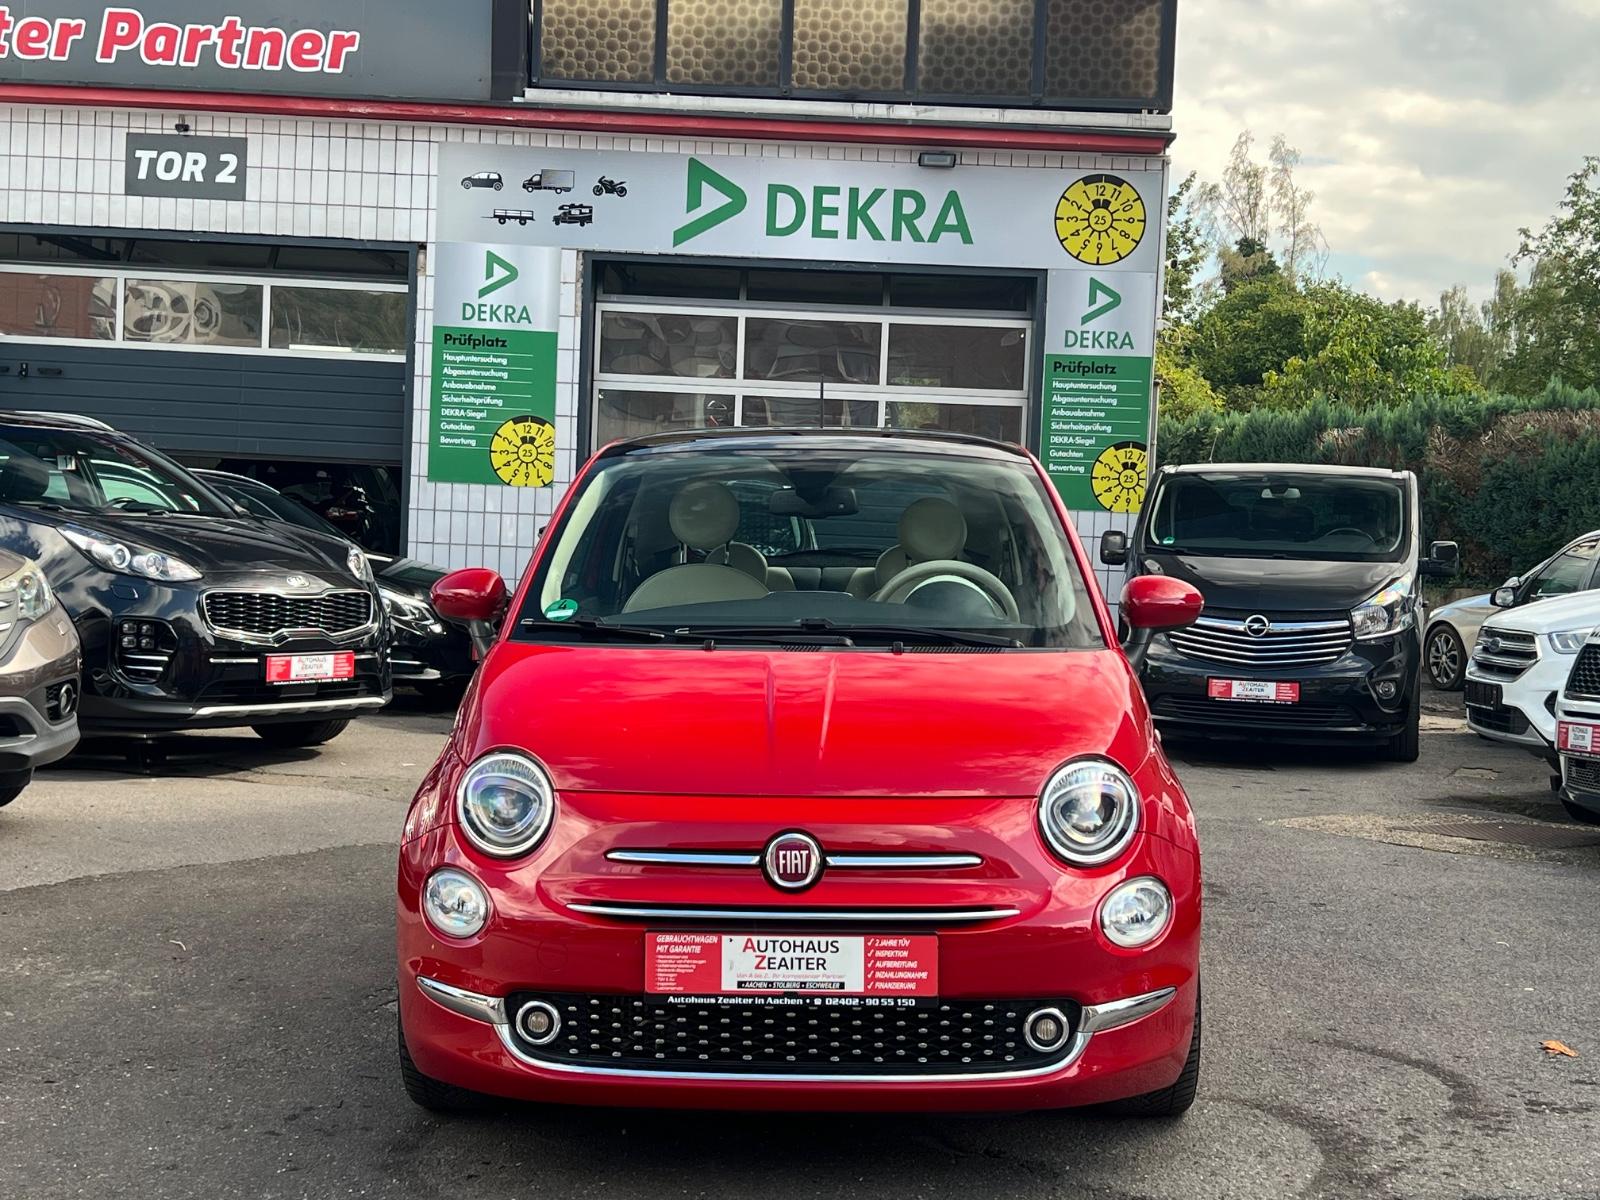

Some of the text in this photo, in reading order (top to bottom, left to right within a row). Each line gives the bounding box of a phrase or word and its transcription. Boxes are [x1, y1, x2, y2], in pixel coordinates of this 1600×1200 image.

[97, 8, 359, 73] Partner
[134, 150, 238, 184] TOR 2
[1095, 184, 1106, 197] 12
[1110, 187, 1122, 202] 11
[1070, 200, 1082, 211] 2
[1119, 198, 1134, 213] 10
[765, 183, 974, 246] DEKRA
[1066, 215, 1079, 223] 3
[1094, 215, 1106, 225] 25
[1119, 229, 1131, 240] 8
[1080, 238, 1091, 251] 5
[462, 302, 533, 325] DEKRA
[443, 333, 508, 350] Prüfplatz
[1064, 329, 1135, 350] DEKRA
[442, 352, 508, 366] Hauptuntersuchung
[442, 366, 509, 380] Abgasuntersuchung
[1053, 361, 1117, 377] Prüfplatz
[441, 380, 497, 391] Anbauabnahme
[1052, 380, 1117, 392] Hauptuntersuchung
[441, 394, 503, 407] Sicherheitsprüfung
[1052, 394, 1118, 406] Abgasuntersuchung
[441, 408, 487, 419] DEKRA-Siegel
[1051, 408, 1106, 418] Anbauabnahme
[440, 422, 475, 431] Gutachten
[523, 424, 532, 434] 12
[1050, 421, 1112, 434] Sicherheitsprüfung
[440, 435, 476, 447] Bewertung
[1050, 436, 1096, 447] DEKRA-Siegel
[522, 449, 533, 458] 25
[1049, 449, 1084, 459] Gutachten
[1124, 450, 1134, 460] 12
[1048, 463, 1085, 475] Bewertung
[1123, 474, 1134, 484] 25
[779, 850, 809, 874] FIAT
[656, 934, 718, 944] GEBRAUCHTWAGEN
[898, 937, 911, 947] TÜV
[656, 944, 701, 954] MIT GARANTIE
[742, 937, 840, 953] AUTOHAUS
[754, 954, 827, 971] ZEAITER
[875, 960, 918, 969] AUFBEREITUNG
[875, 971, 929, 980] INZAHLUNGNAHME
[745, 981, 768, 989] AACHEN
[773, 981, 800, 989] STOLBERG
[875, 982, 917, 990] FINANZIERUNG
[667, 996, 716, 1004] Autohaus
[717, 996, 754, 1004] Zeaiter
[754, 996, 764, 1005] in
[766, 996, 803, 1005] Aachen
[825, 997, 859, 1006] 02402
[881, 997, 894, 1006] 55
[897, 998, 916, 1006] 150
